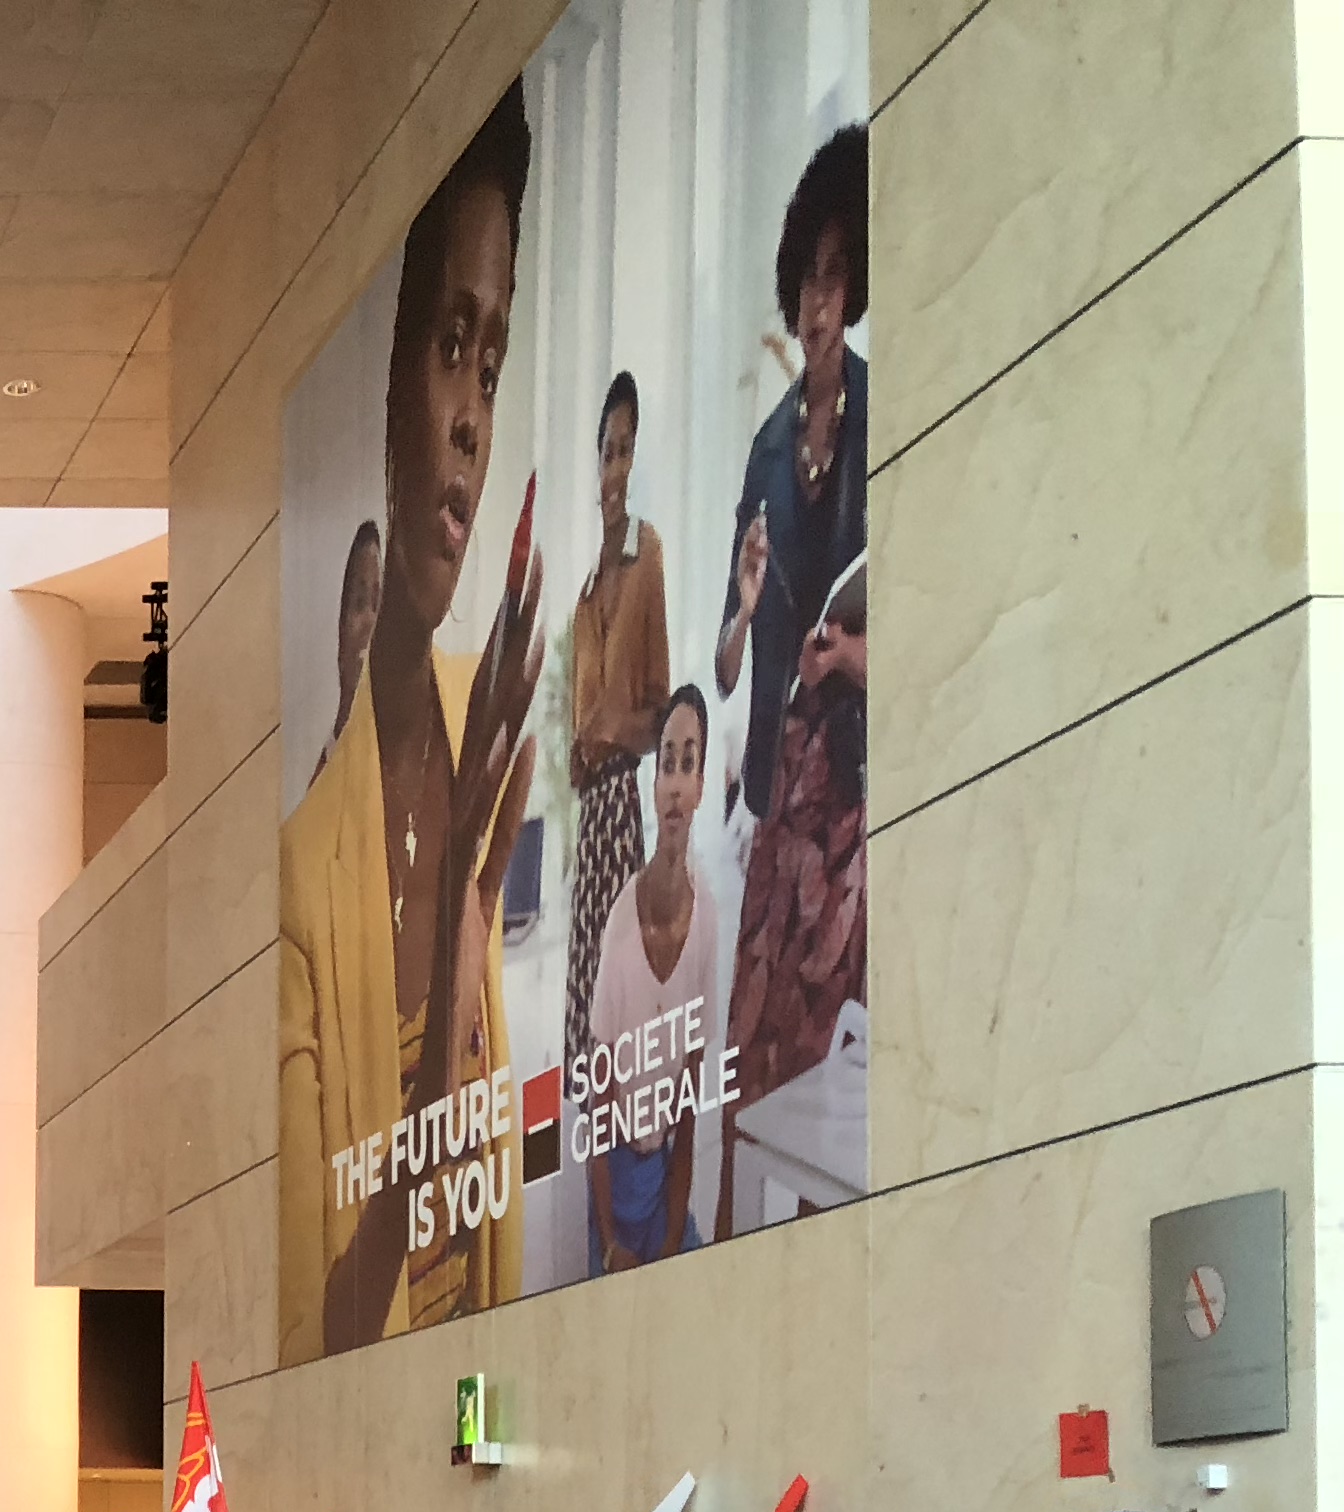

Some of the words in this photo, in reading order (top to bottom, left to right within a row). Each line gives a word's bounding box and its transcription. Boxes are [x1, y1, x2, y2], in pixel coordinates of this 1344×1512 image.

[570, 996, 705, 1103] SOCIETE
[570, 1046, 741, 1163] GENERALE
[331, 1130, 384, 1211] THE
[390, 1066, 511, 1183] FUTURE
[408, 1181, 437, 1251] IS
[442, 1146, 511, 1237] YOU
